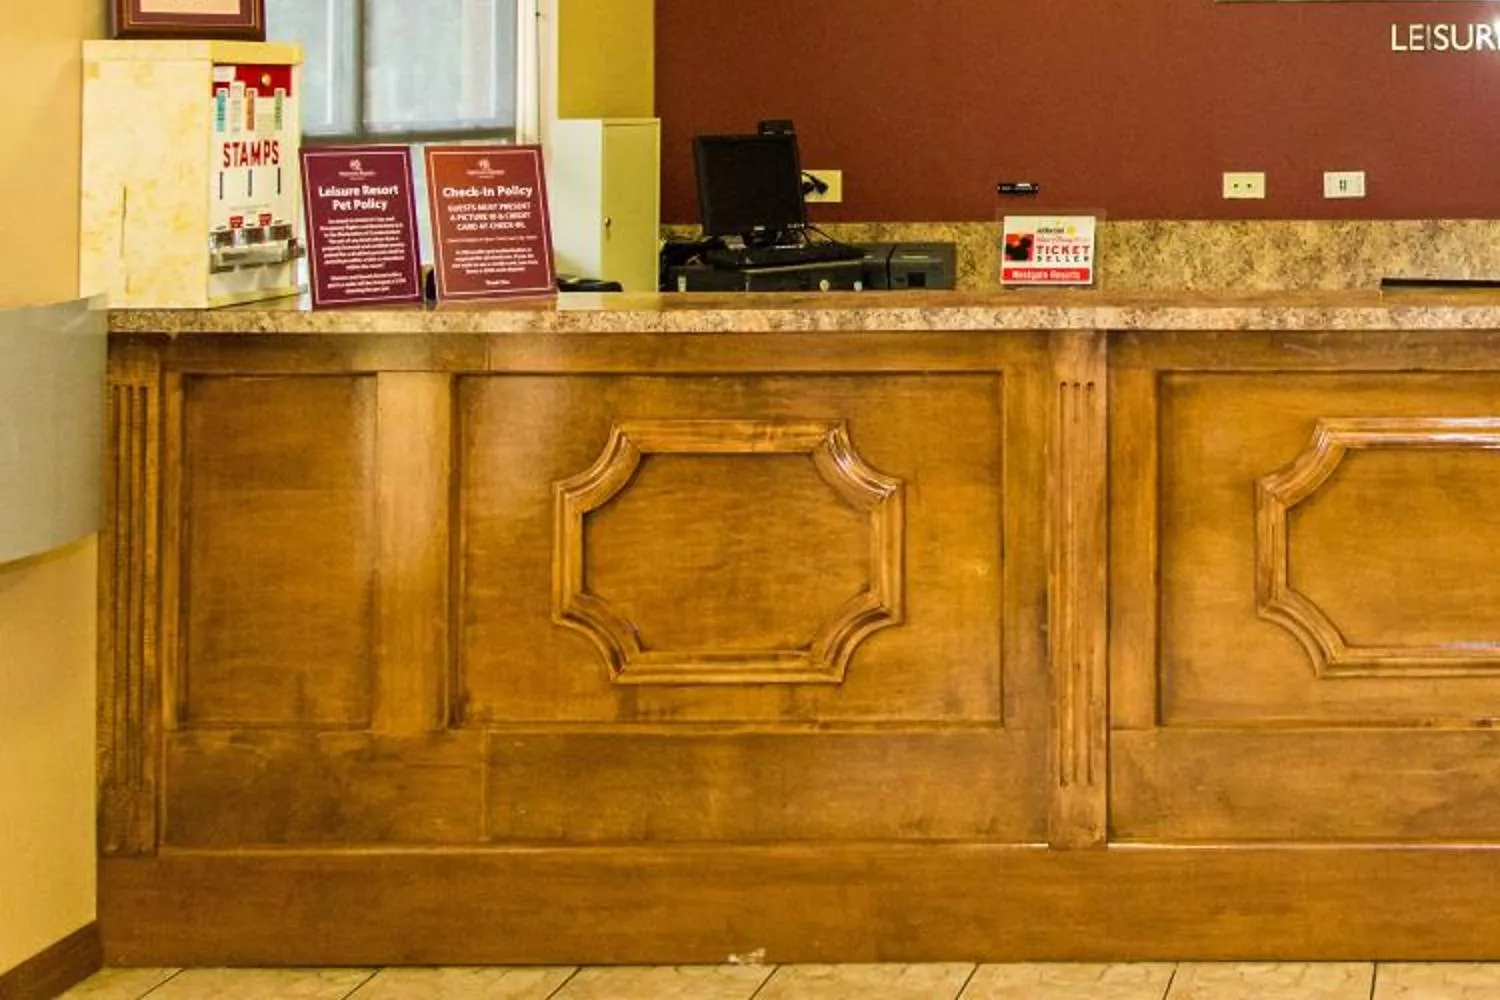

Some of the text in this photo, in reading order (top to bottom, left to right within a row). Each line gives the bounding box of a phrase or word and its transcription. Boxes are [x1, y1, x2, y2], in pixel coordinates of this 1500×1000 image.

[223, 140, 280, 168] STAMPS
[318, 184, 399, 197] Leisure Resort
[498, 185, 533, 198] Policy
[332, 198, 388, 211] Pet Policy
[1036, 245, 1090, 255] TICKET
